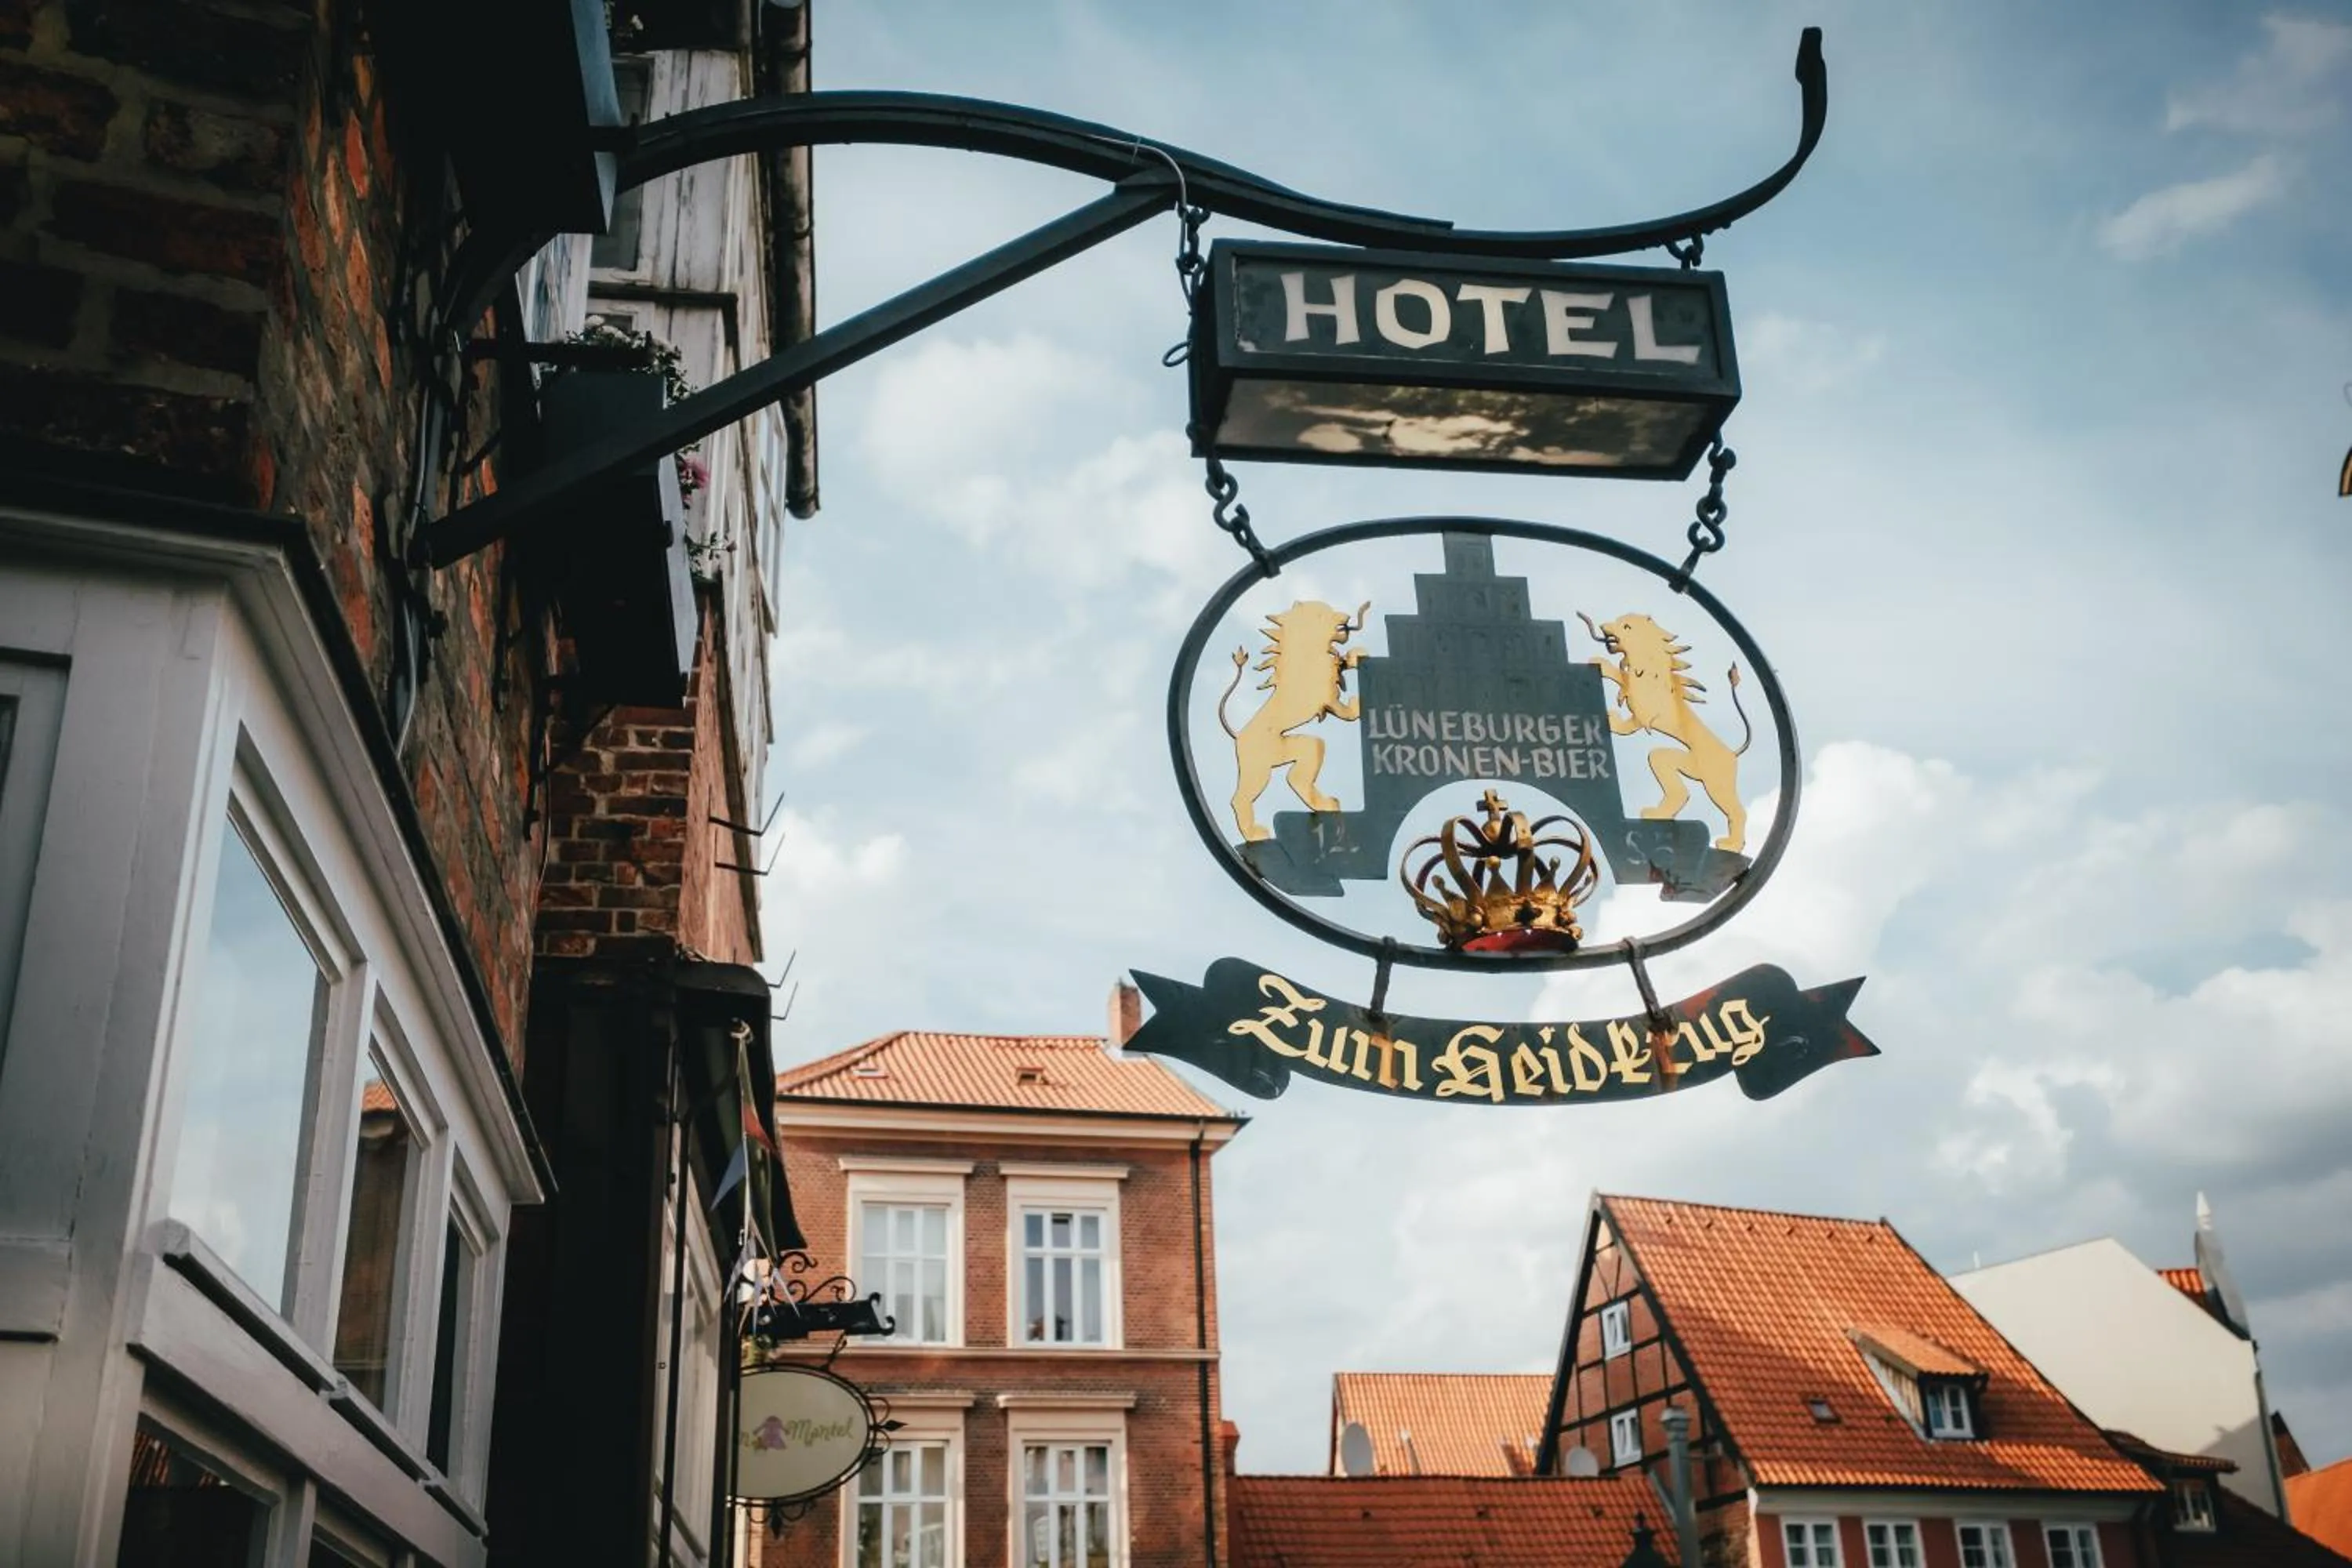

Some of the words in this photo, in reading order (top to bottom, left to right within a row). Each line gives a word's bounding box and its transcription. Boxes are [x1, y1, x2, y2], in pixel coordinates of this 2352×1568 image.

[1280, 272, 1702, 365] HOTEL
[1367, 704, 1607, 745] LÜNEBURGER
[1371, 742, 1610, 779] KRONEN-BIER
[1228, 974, 1424, 1091] Zum
[1432, 999, 1770, 1103] Heidkrug
